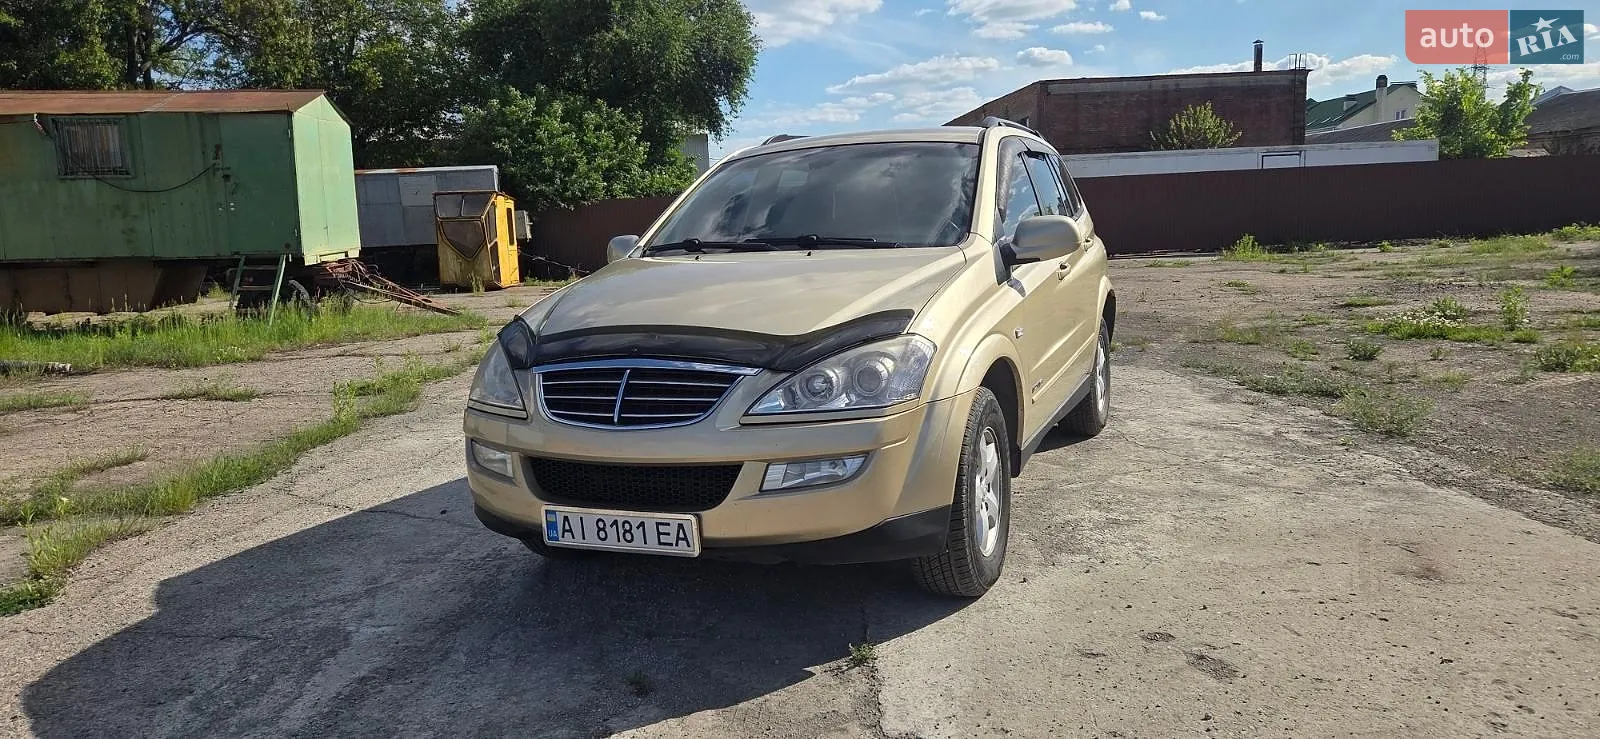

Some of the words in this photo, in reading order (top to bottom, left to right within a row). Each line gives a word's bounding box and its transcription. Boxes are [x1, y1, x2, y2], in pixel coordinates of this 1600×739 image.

[548, 529, 559, 537] UA
[561, 515, 586, 540] AI
[595, 518, 648, 545] 8181
[655, 521, 691, 548] EA
